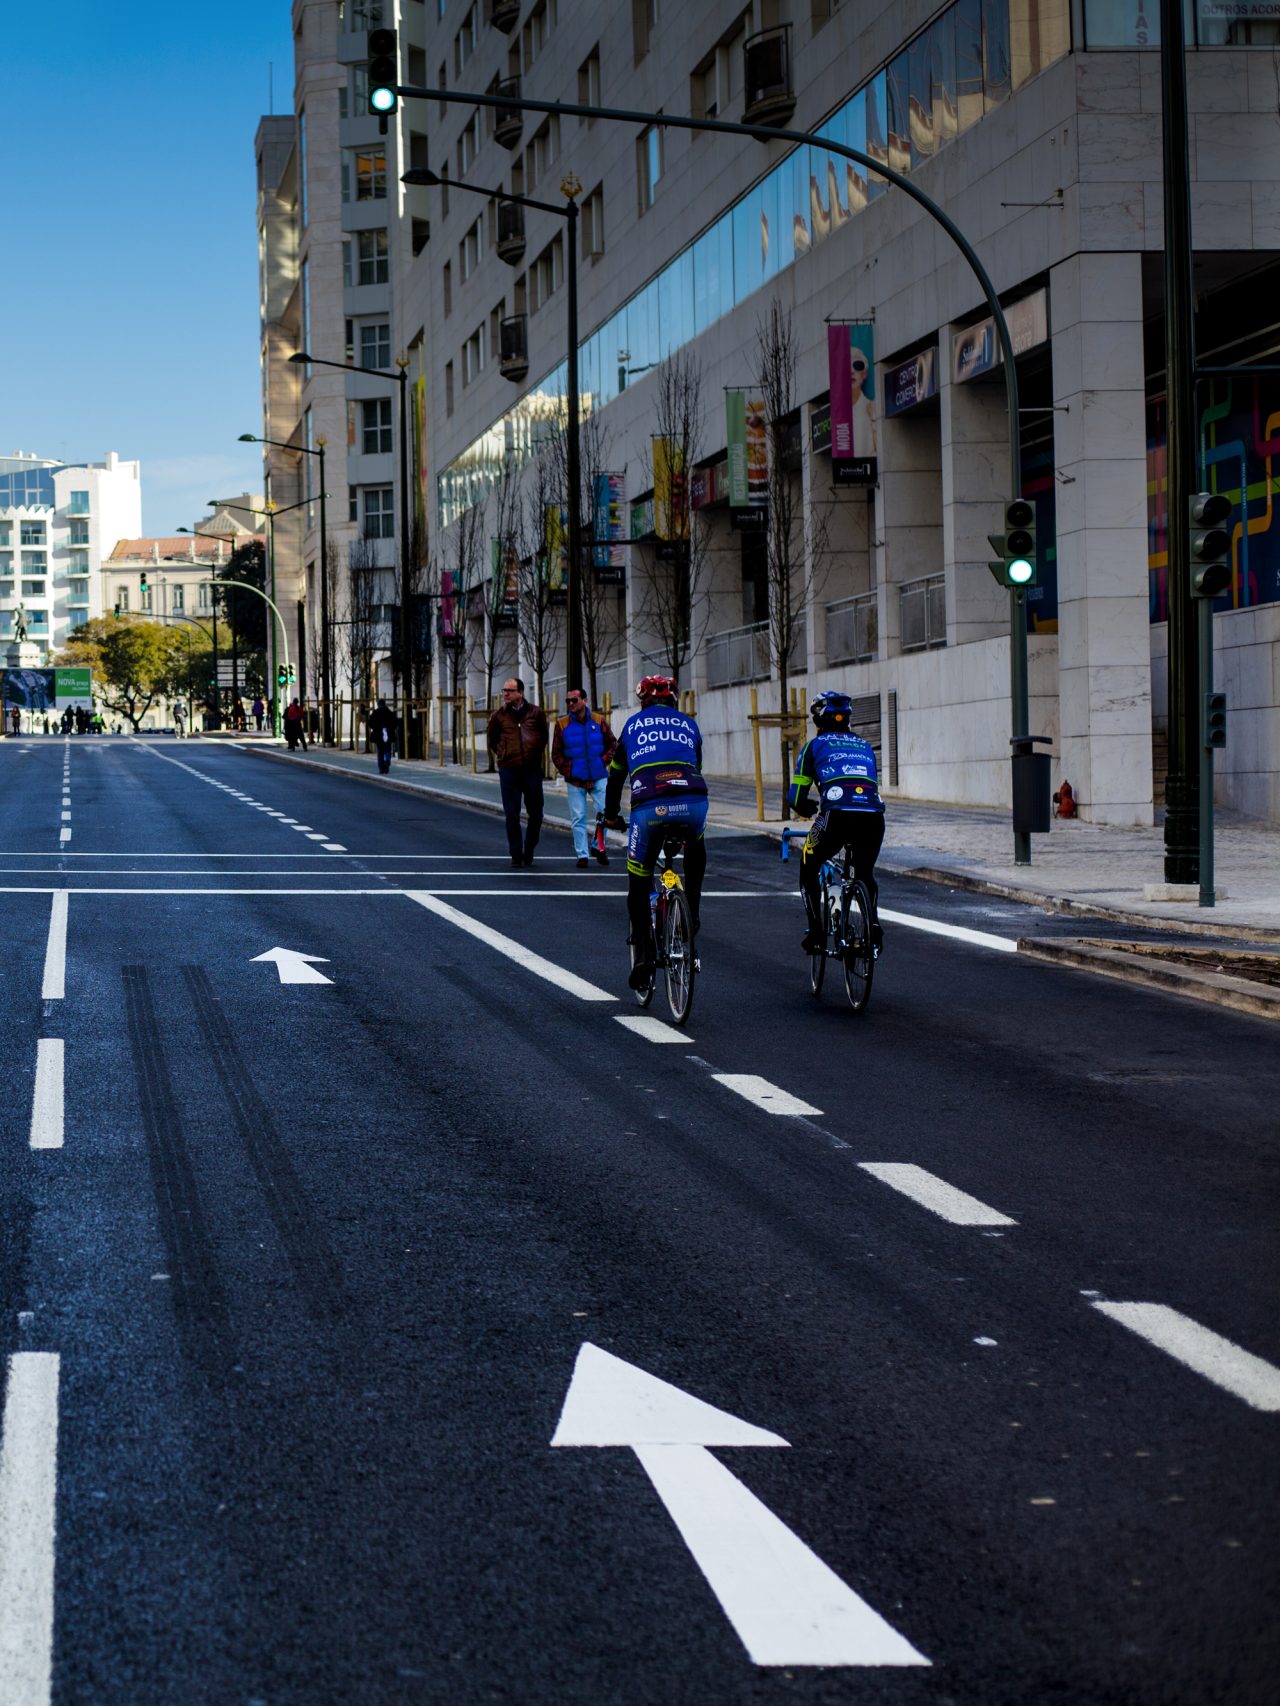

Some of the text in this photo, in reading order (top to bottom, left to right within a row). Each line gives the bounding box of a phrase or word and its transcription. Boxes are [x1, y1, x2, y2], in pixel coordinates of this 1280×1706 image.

[1202, 4, 1248, 15] OUTROS
[837, 423, 850, 451] MODA
[58, 678, 75, 686] NOVA
[628, 717, 690, 735] FÁBRICA
[637, 731, 694, 749] ÓCULOS
[631, 745, 656, 760] CACÉM
